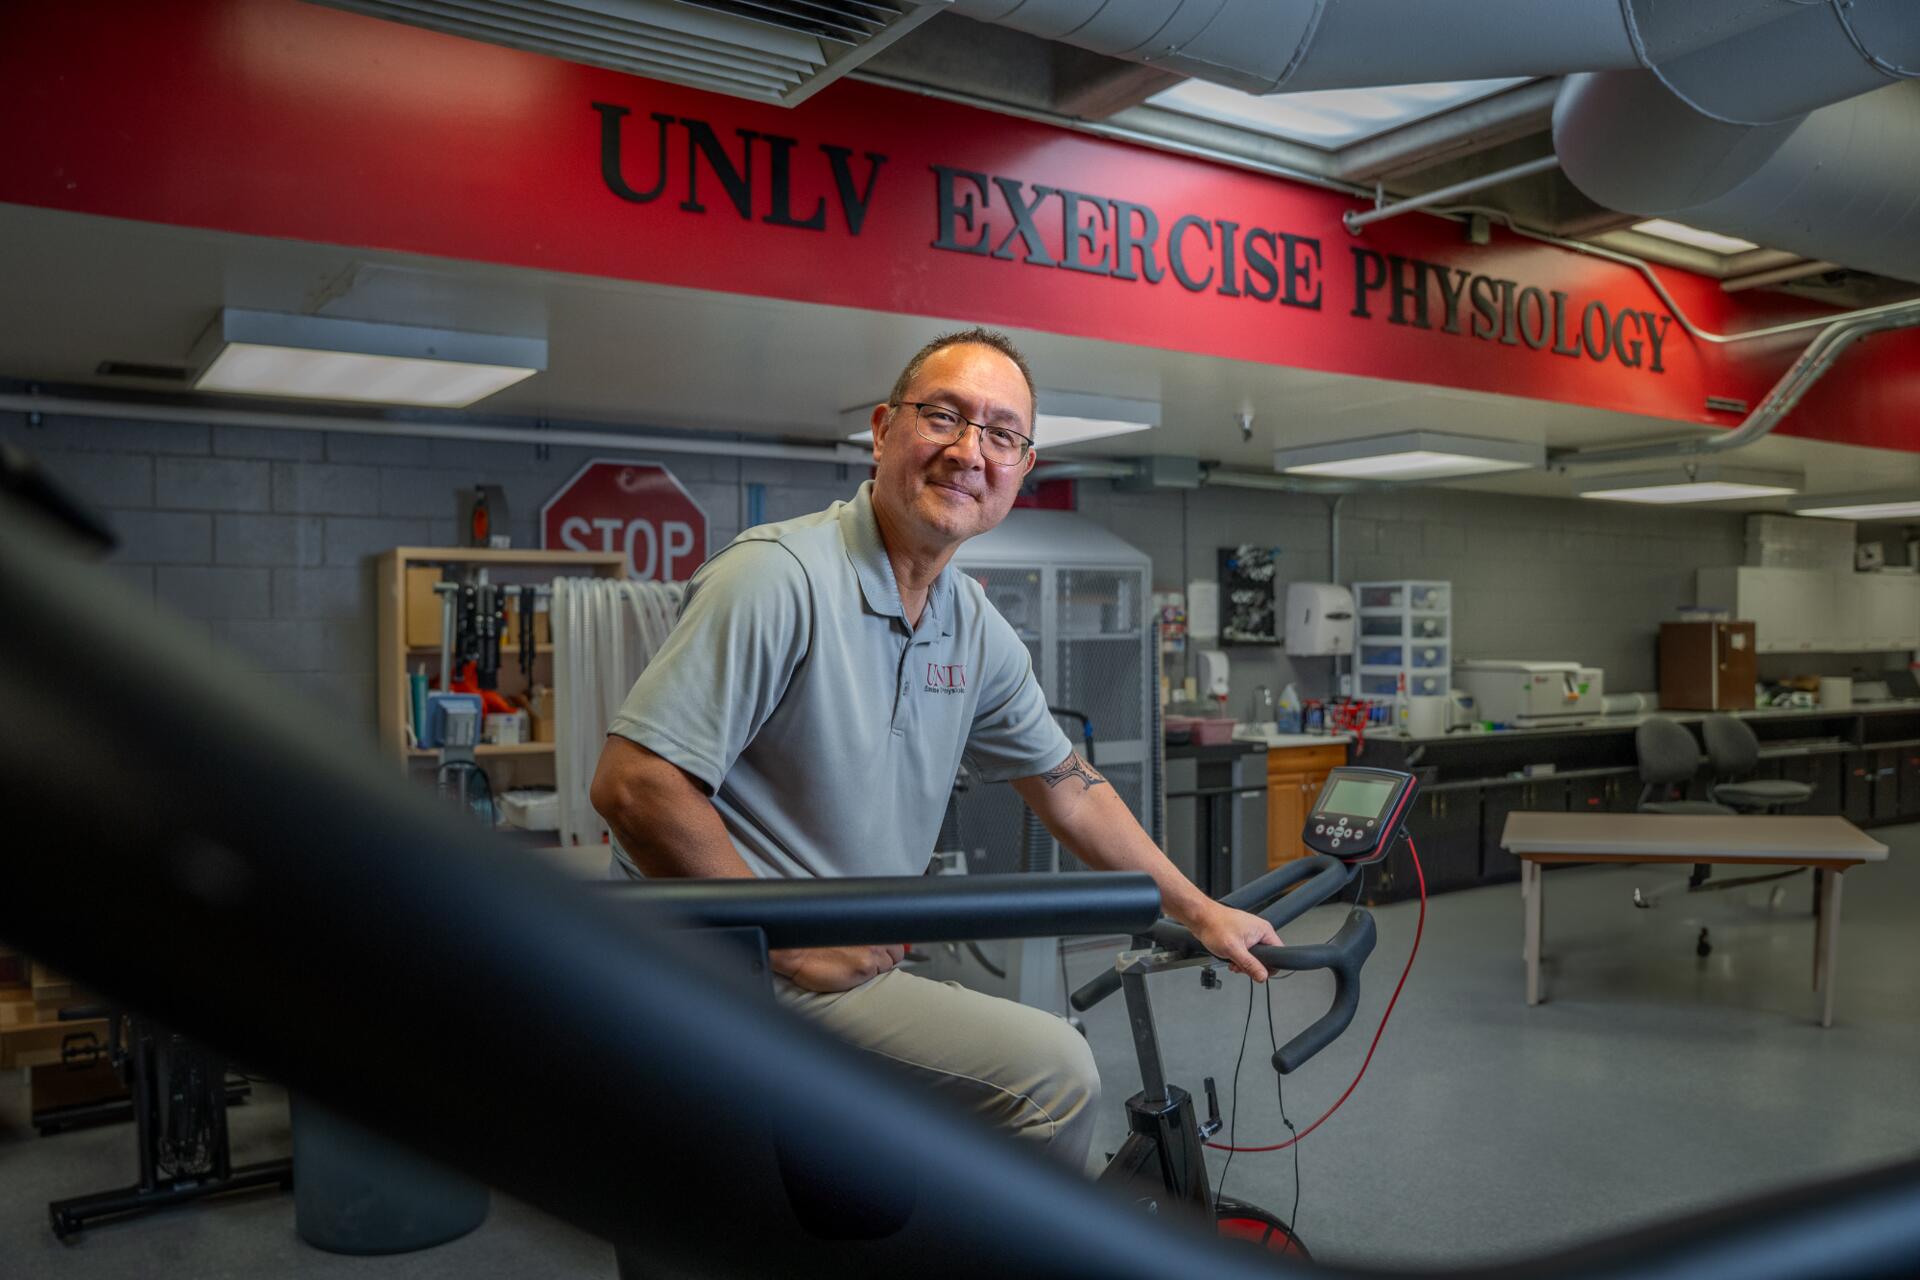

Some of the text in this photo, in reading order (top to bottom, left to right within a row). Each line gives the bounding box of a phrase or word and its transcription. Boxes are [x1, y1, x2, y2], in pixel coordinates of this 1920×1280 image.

[592, 102, 1672, 374] UNLV EXERCISE PHYSIOLOGY
[560, 516, 695, 582] STOP
